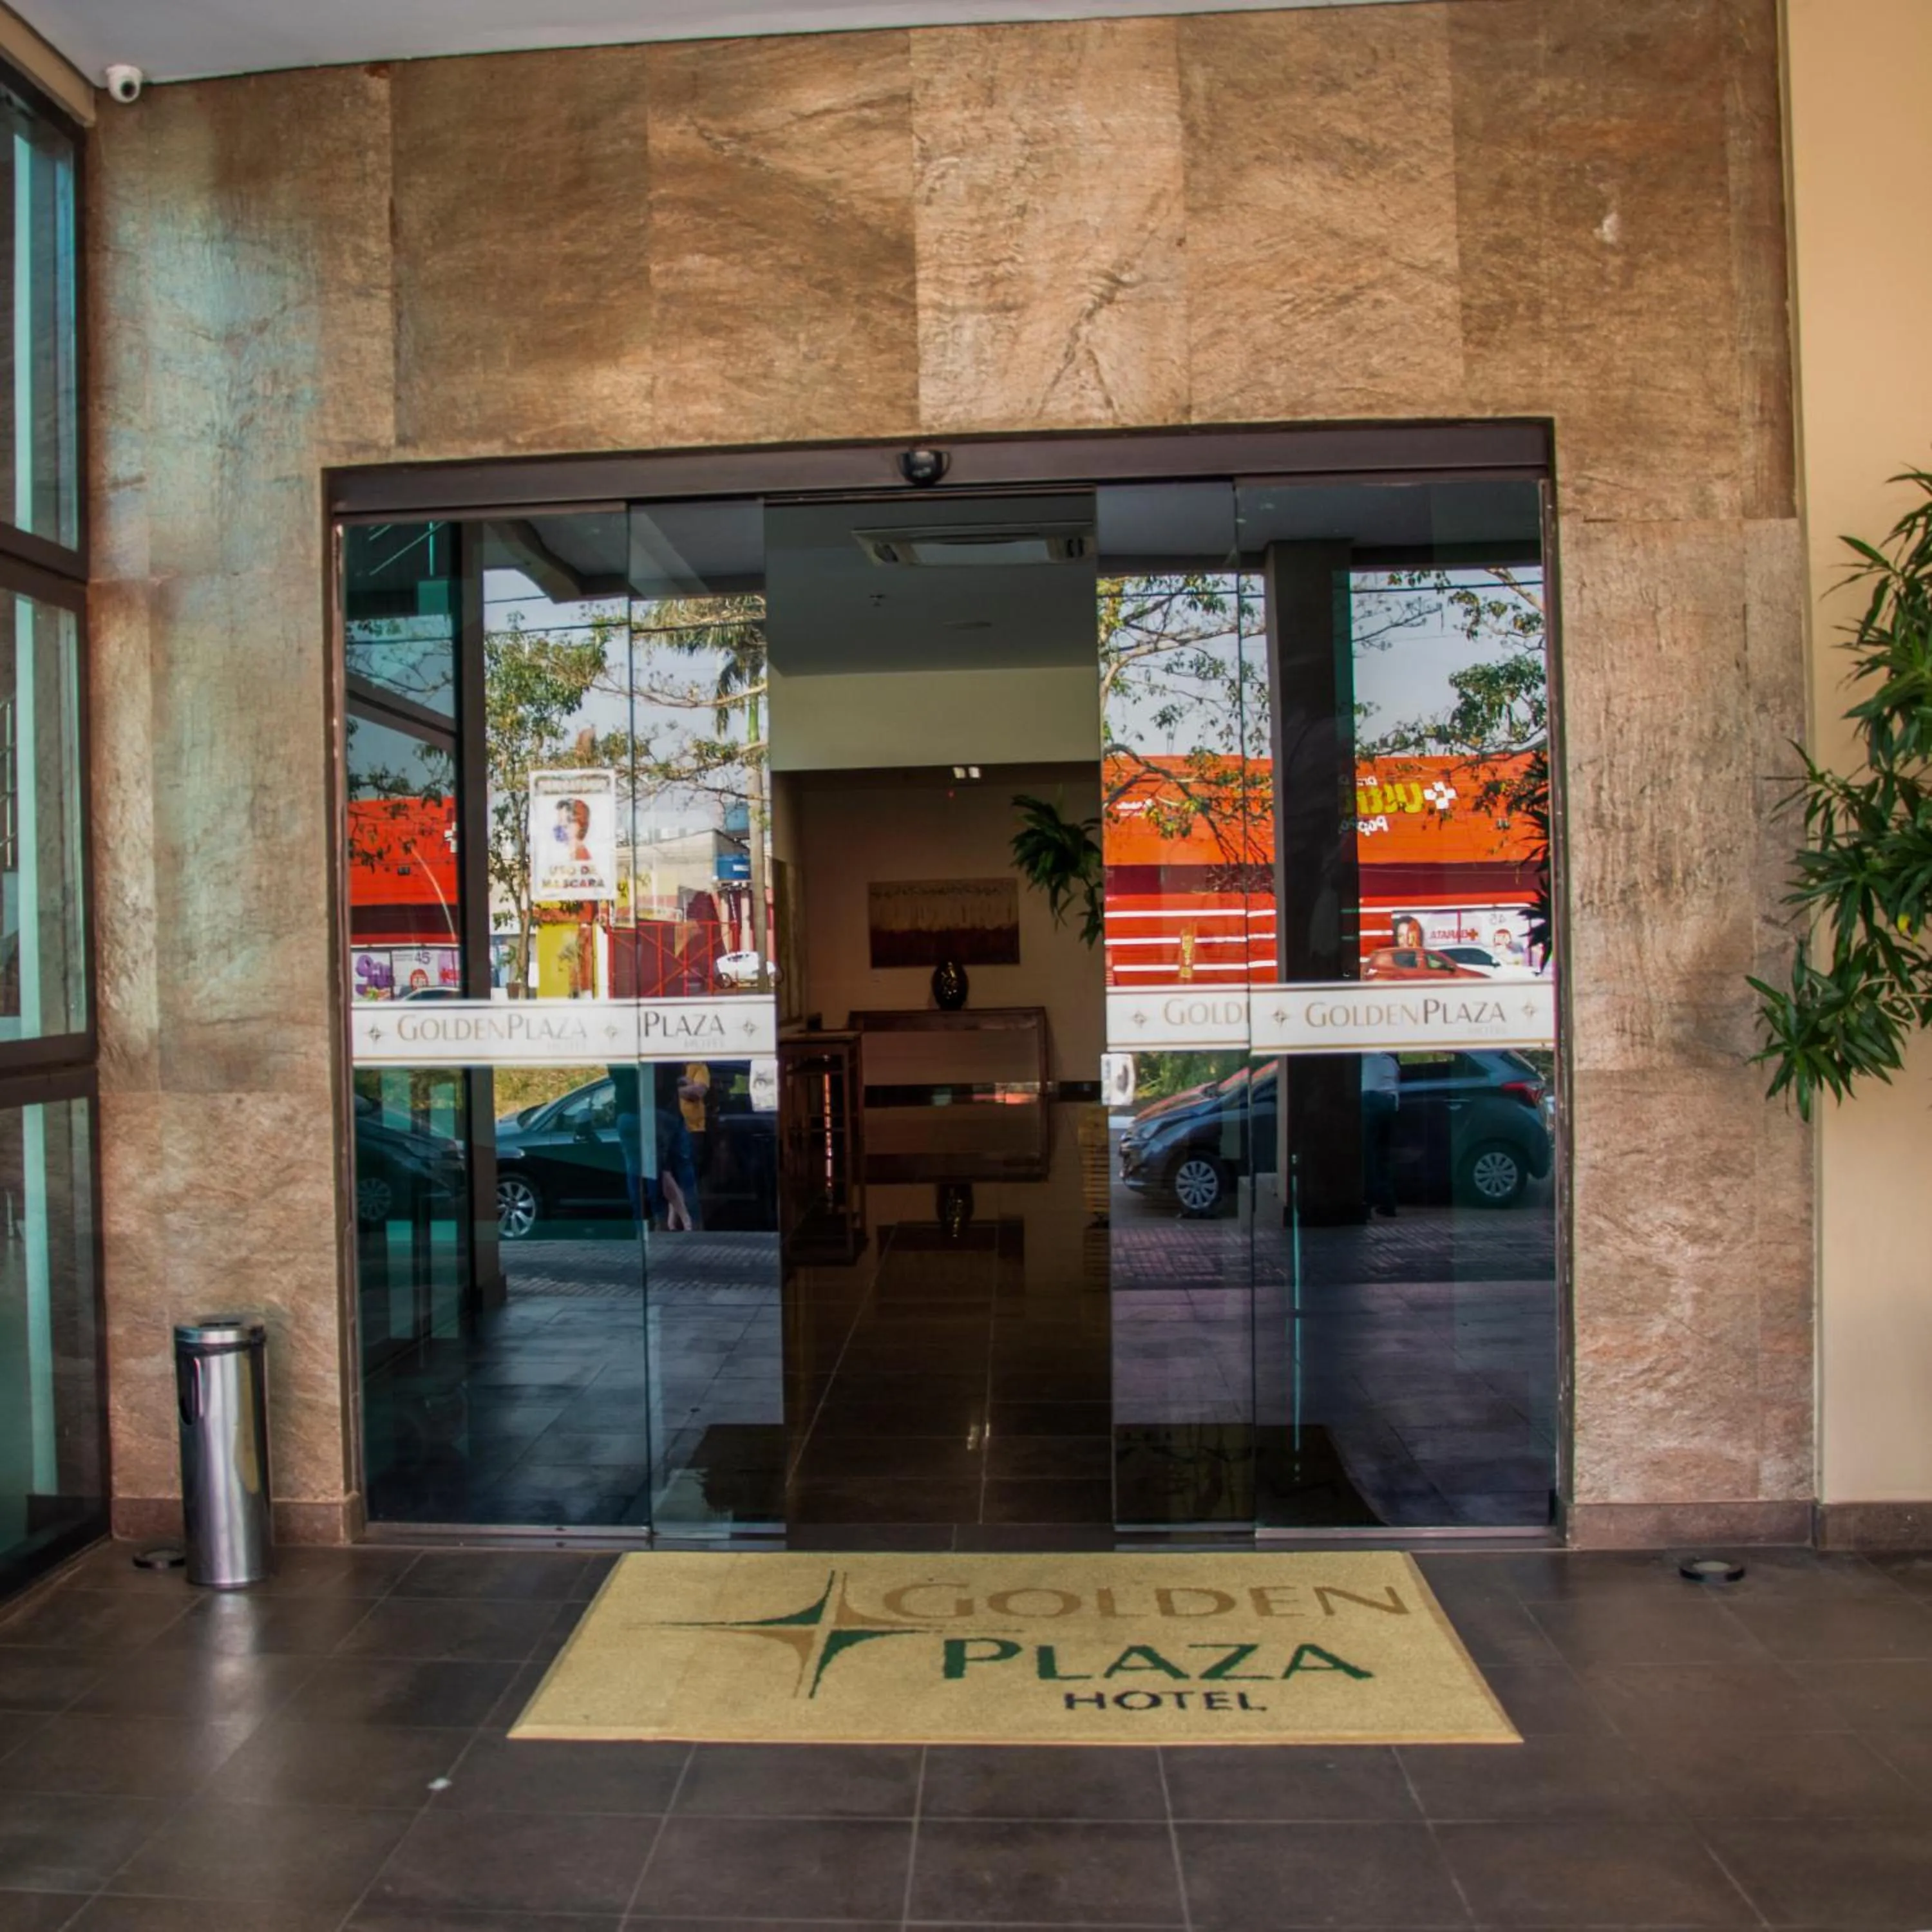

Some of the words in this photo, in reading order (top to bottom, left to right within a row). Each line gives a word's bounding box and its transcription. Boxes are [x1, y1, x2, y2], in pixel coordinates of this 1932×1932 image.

[414, 951, 431, 965] 45
[644, 1010, 726, 1037] PLAZA
[1164, 998, 1249, 1026] GOLD
[883, 1583, 1410, 1619] GOLDEN
[942, 1638, 1375, 1680] PLAZA
[1064, 1691, 1267, 1711] HOTEL
